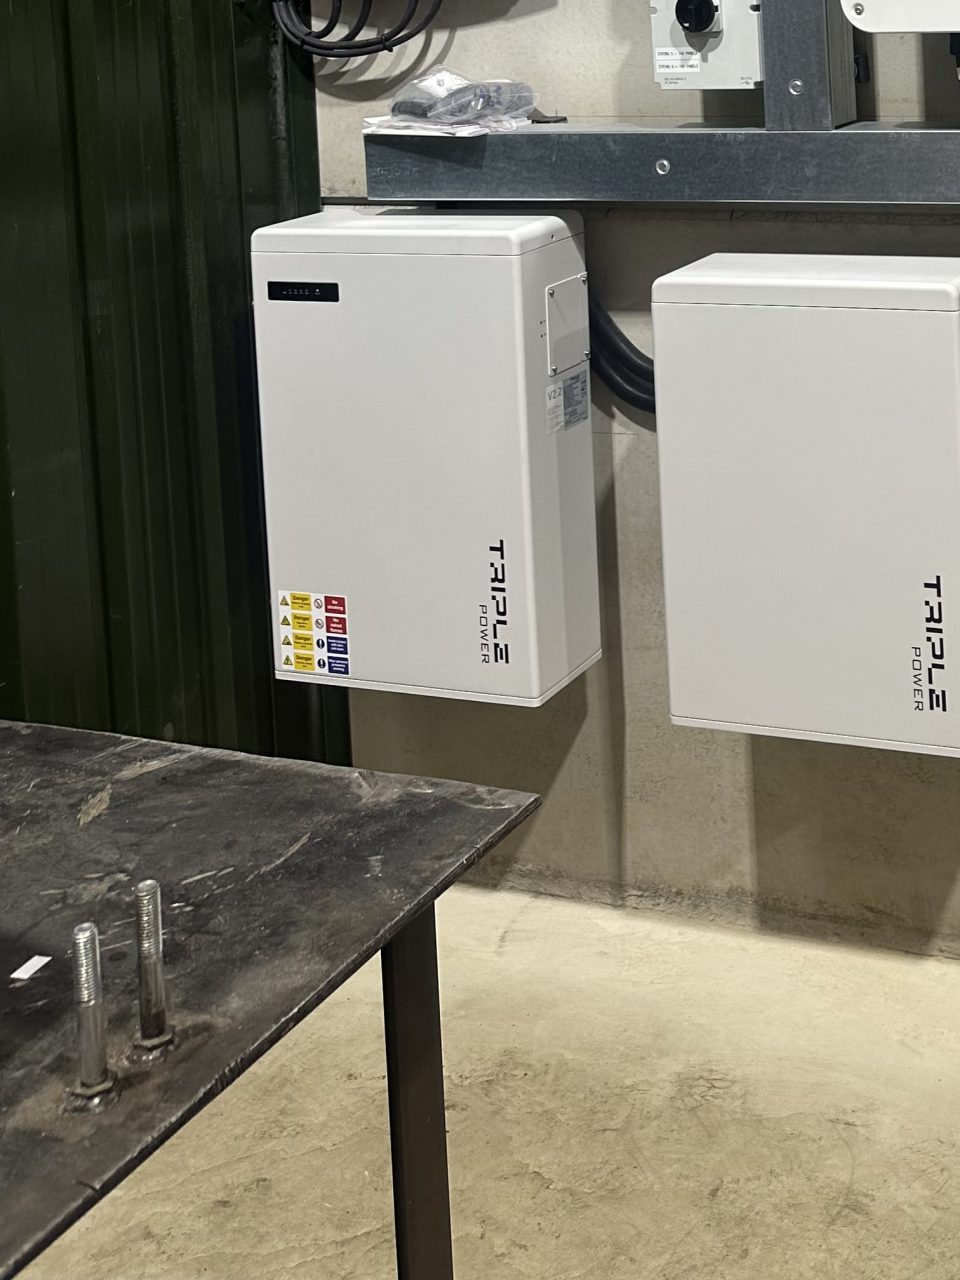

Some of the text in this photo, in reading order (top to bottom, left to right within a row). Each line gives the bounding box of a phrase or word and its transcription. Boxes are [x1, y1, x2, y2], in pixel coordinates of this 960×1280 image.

[479, 604, 490, 664] POWER
[489, 539, 509, 664] TRIPLE
[924, 575, 947, 712] TRIPLE
[912, 646, 924, 711] POWER
